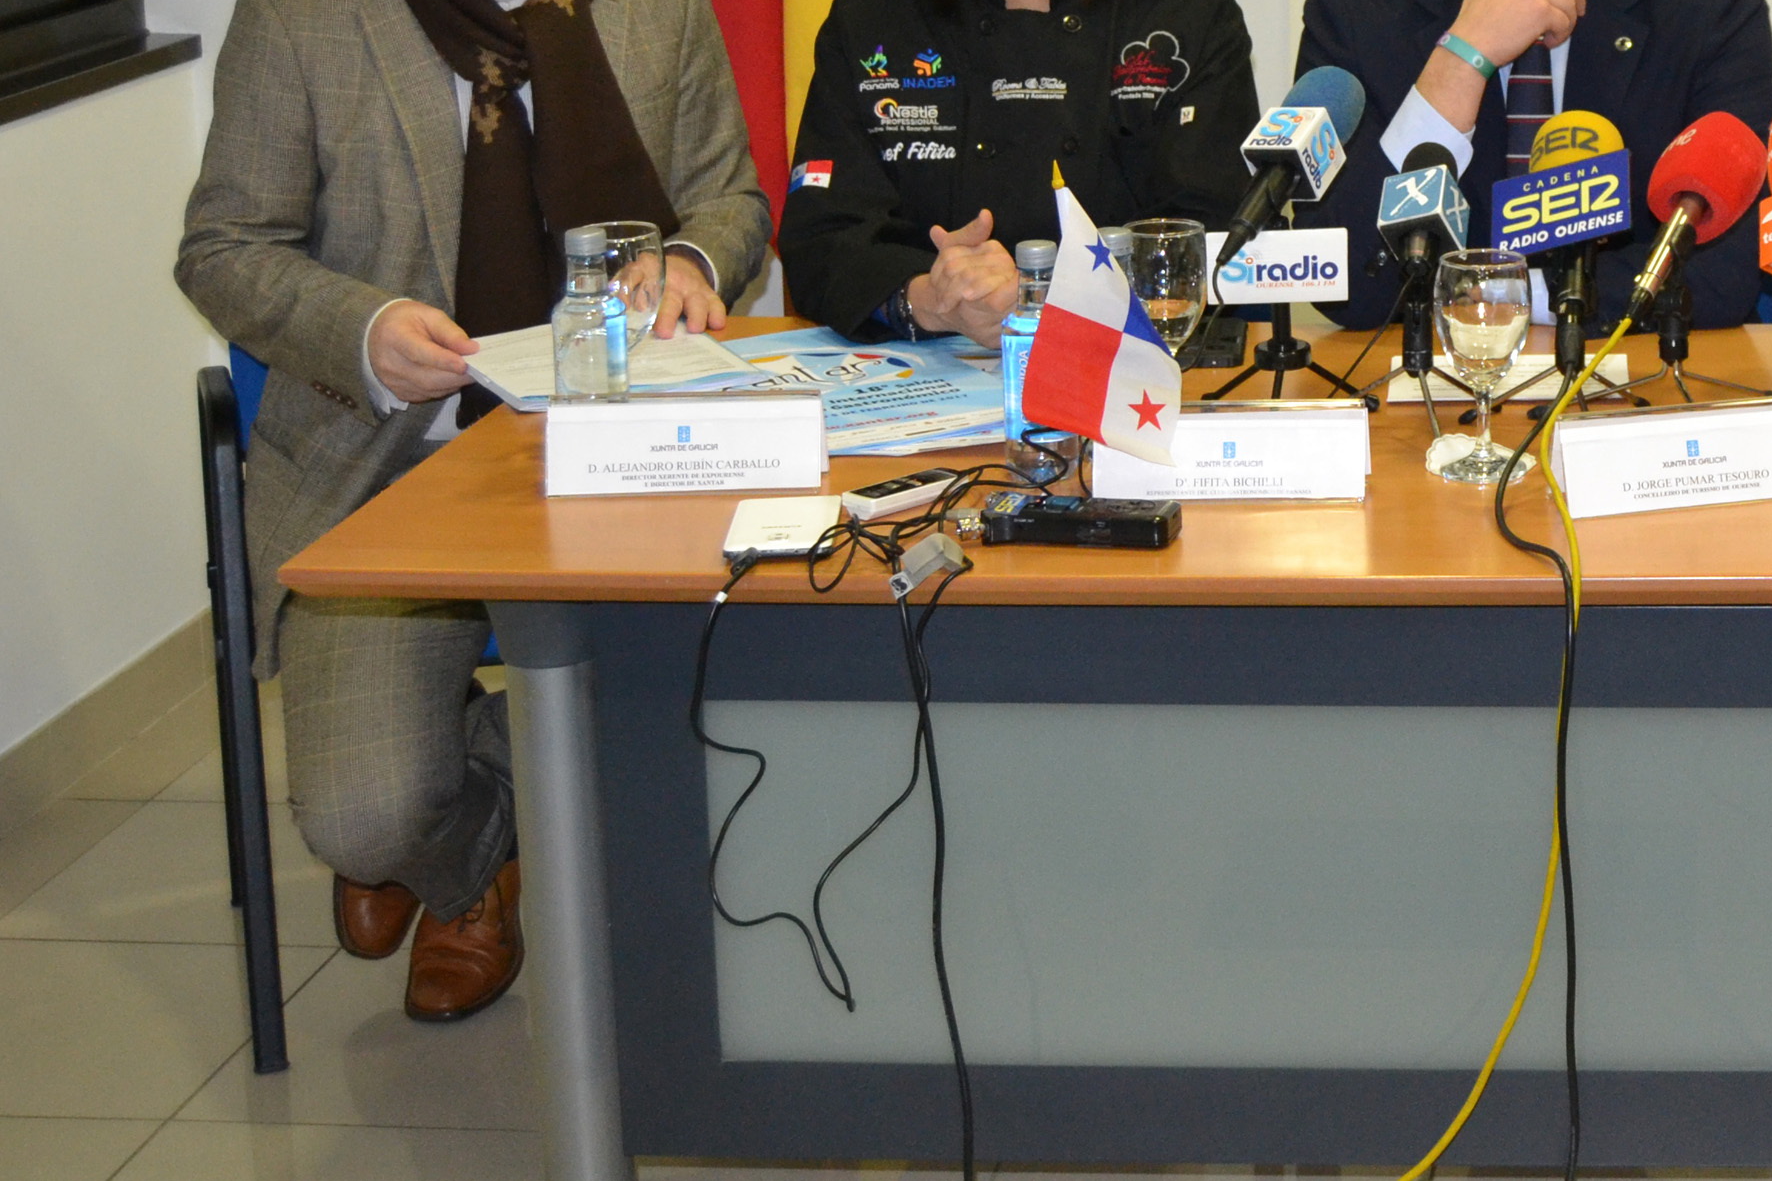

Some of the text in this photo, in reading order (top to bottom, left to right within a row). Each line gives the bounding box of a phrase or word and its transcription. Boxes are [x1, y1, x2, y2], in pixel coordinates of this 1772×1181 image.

[902, 75, 956, 89] INADEH
[1249, 135, 1293, 146] radio
[1530, 126, 1599, 171] SER
[907, 141, 957, 160] Fifita
[1302, 147, 1321, 190] radio
[1523, 166, 1599, 192] CADENA
[1502, 174, 1621, 234] SER
[1499, 210, 1624, 251] RADIO OURENSE
[650, 443, 719, 452] XUNTA DE GALICIA
[587, 458, 781, 474] D. ALEJANDRO RUBÍN CARBALLO
[1662, 456, 1727, 469] XUNTA DE GALICIA
[1193, 477, 1230, 487] FIFITA
[1622, 469, 1770, 492] D. JORGE PUMAR TESOURO
